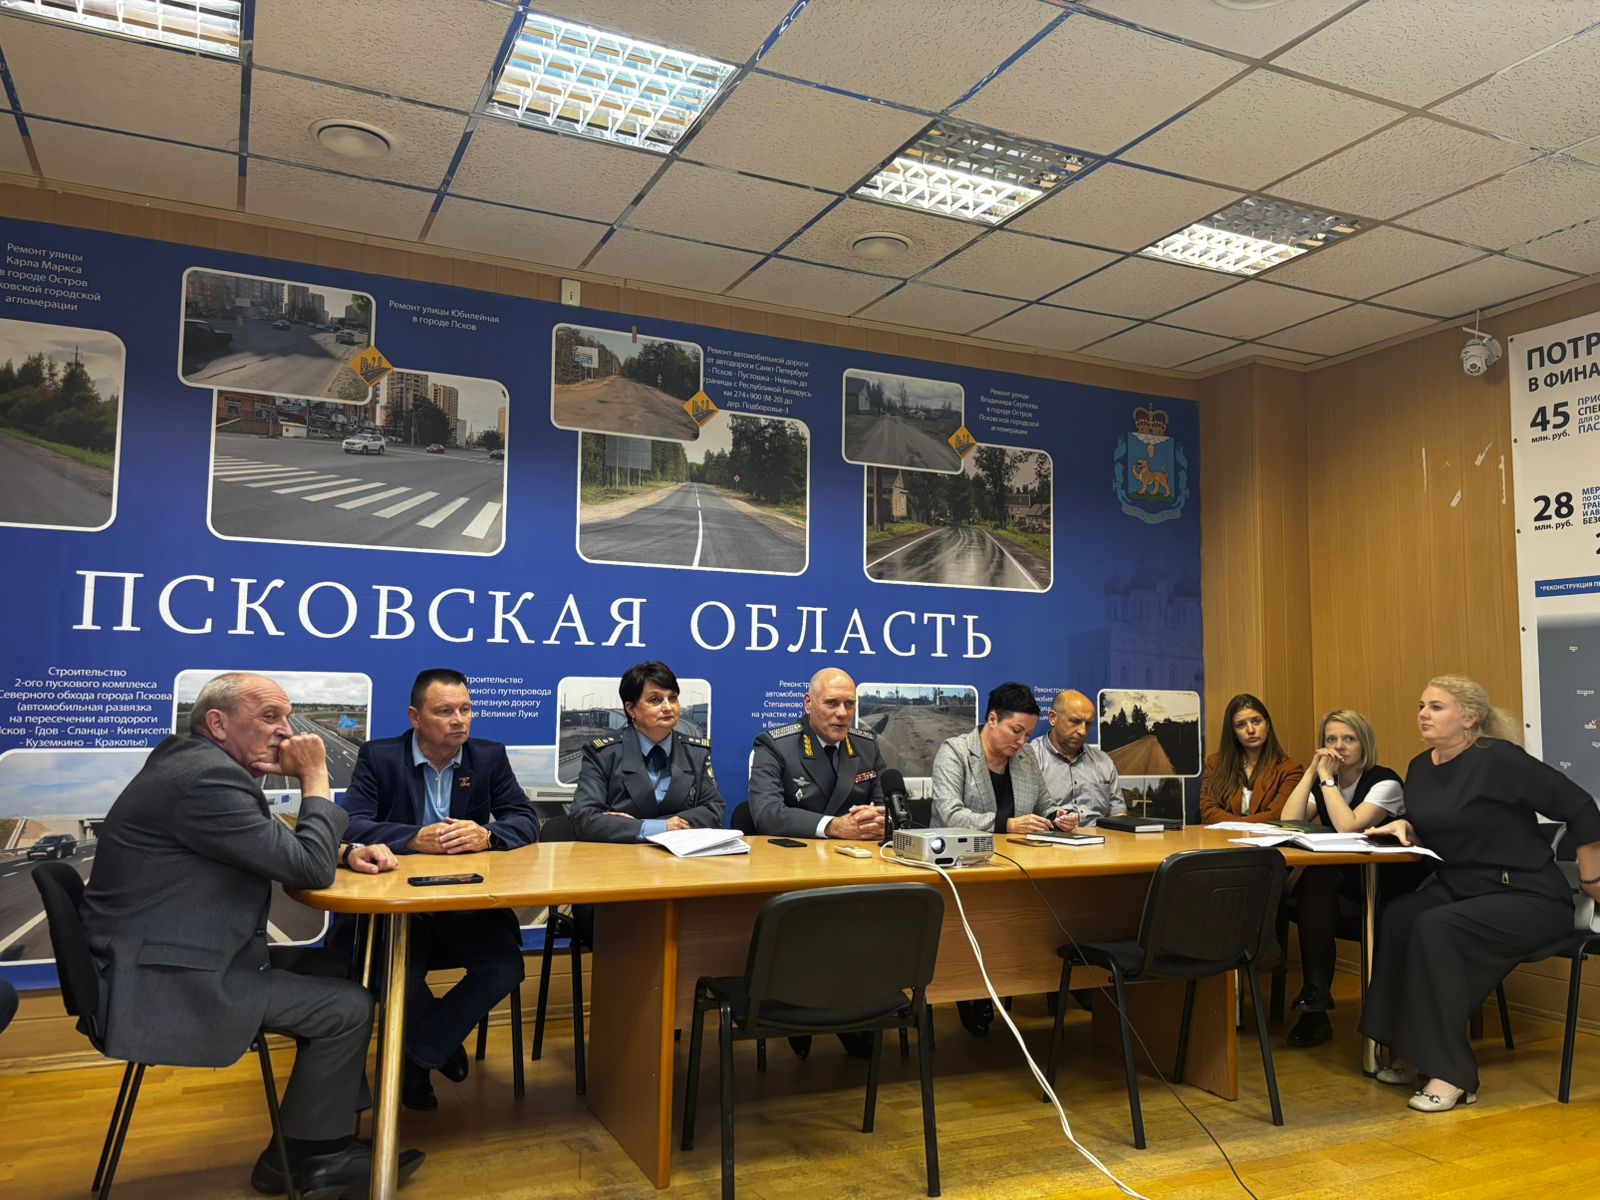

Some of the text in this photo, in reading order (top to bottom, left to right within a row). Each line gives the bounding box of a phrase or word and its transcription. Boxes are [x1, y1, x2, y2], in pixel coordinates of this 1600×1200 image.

[7, 242, 83, 261] Ремонт улицы
[6, 256, 82, 273] Карла Маркса
[8, 270, 46, 282] городе
[48, 274, 88, 287] Остров
[44, 288, 100, 301] городской
[6, 295, 78, 311] агломерации
[389, 300, 500, 323] Ремонт улицы Юбилейная
[420, 318, 449, 328] городе
[451, 320, 477, 331] Псков
[707, 346, 809, 368] Ремонт автомобильной дороги
[1527, 332, 1600, 371] ПОТР
[716, 360, 755, 370] автодороги
[712, 368, 732, 376] Псков
[738, 371, 770, 382] Пустошка
[774, 376, 799, 386] Невель
[1529, 362, 1600, 392] В ФИНА
[704, 378, 733, 387] границы
[738, 380, 781, 393] Республикой
[782, 386, 812, 398] Беларусь
[1530, 401, 1570, 432] 45
[1552, 430, 1570, 441] руб.
[1533, 492, 1574, 522] 28
[1555, 520, 1573, 530] руб.
[73, 570, 992, 659] ПСКОВСКАЯ ОБЛАСТЬ
[48, 666, 127, 678] Строительство
[15, 679, 157, 690] 2-ого пускового комплекса
[466, 676, 523, 684] троительство
[57, 691, 94, 700] обхода
[97, 693, 133, 701] города
[136, 692, 172, 700] Пскова
[17, 702, 152, 713] (автомобильная развязка
[511, 700, 540, 708] дорогу
[764, 700, 803, 708] Степанково
[25, 716, 95, 724] пересечении
[98, 716, 158, 725] автодороги
[518, 710, 539, 719] Луки
[0, 727, 26, 735] сков
[35, 726, 58, 736] Гдов
[67, 726, 108, 736] Сланцы
[117, 726, 172, 736] Кингисепп
[26, 738, 84, 749] Куземкино
[95, 738, 148, 748] Краколье)
